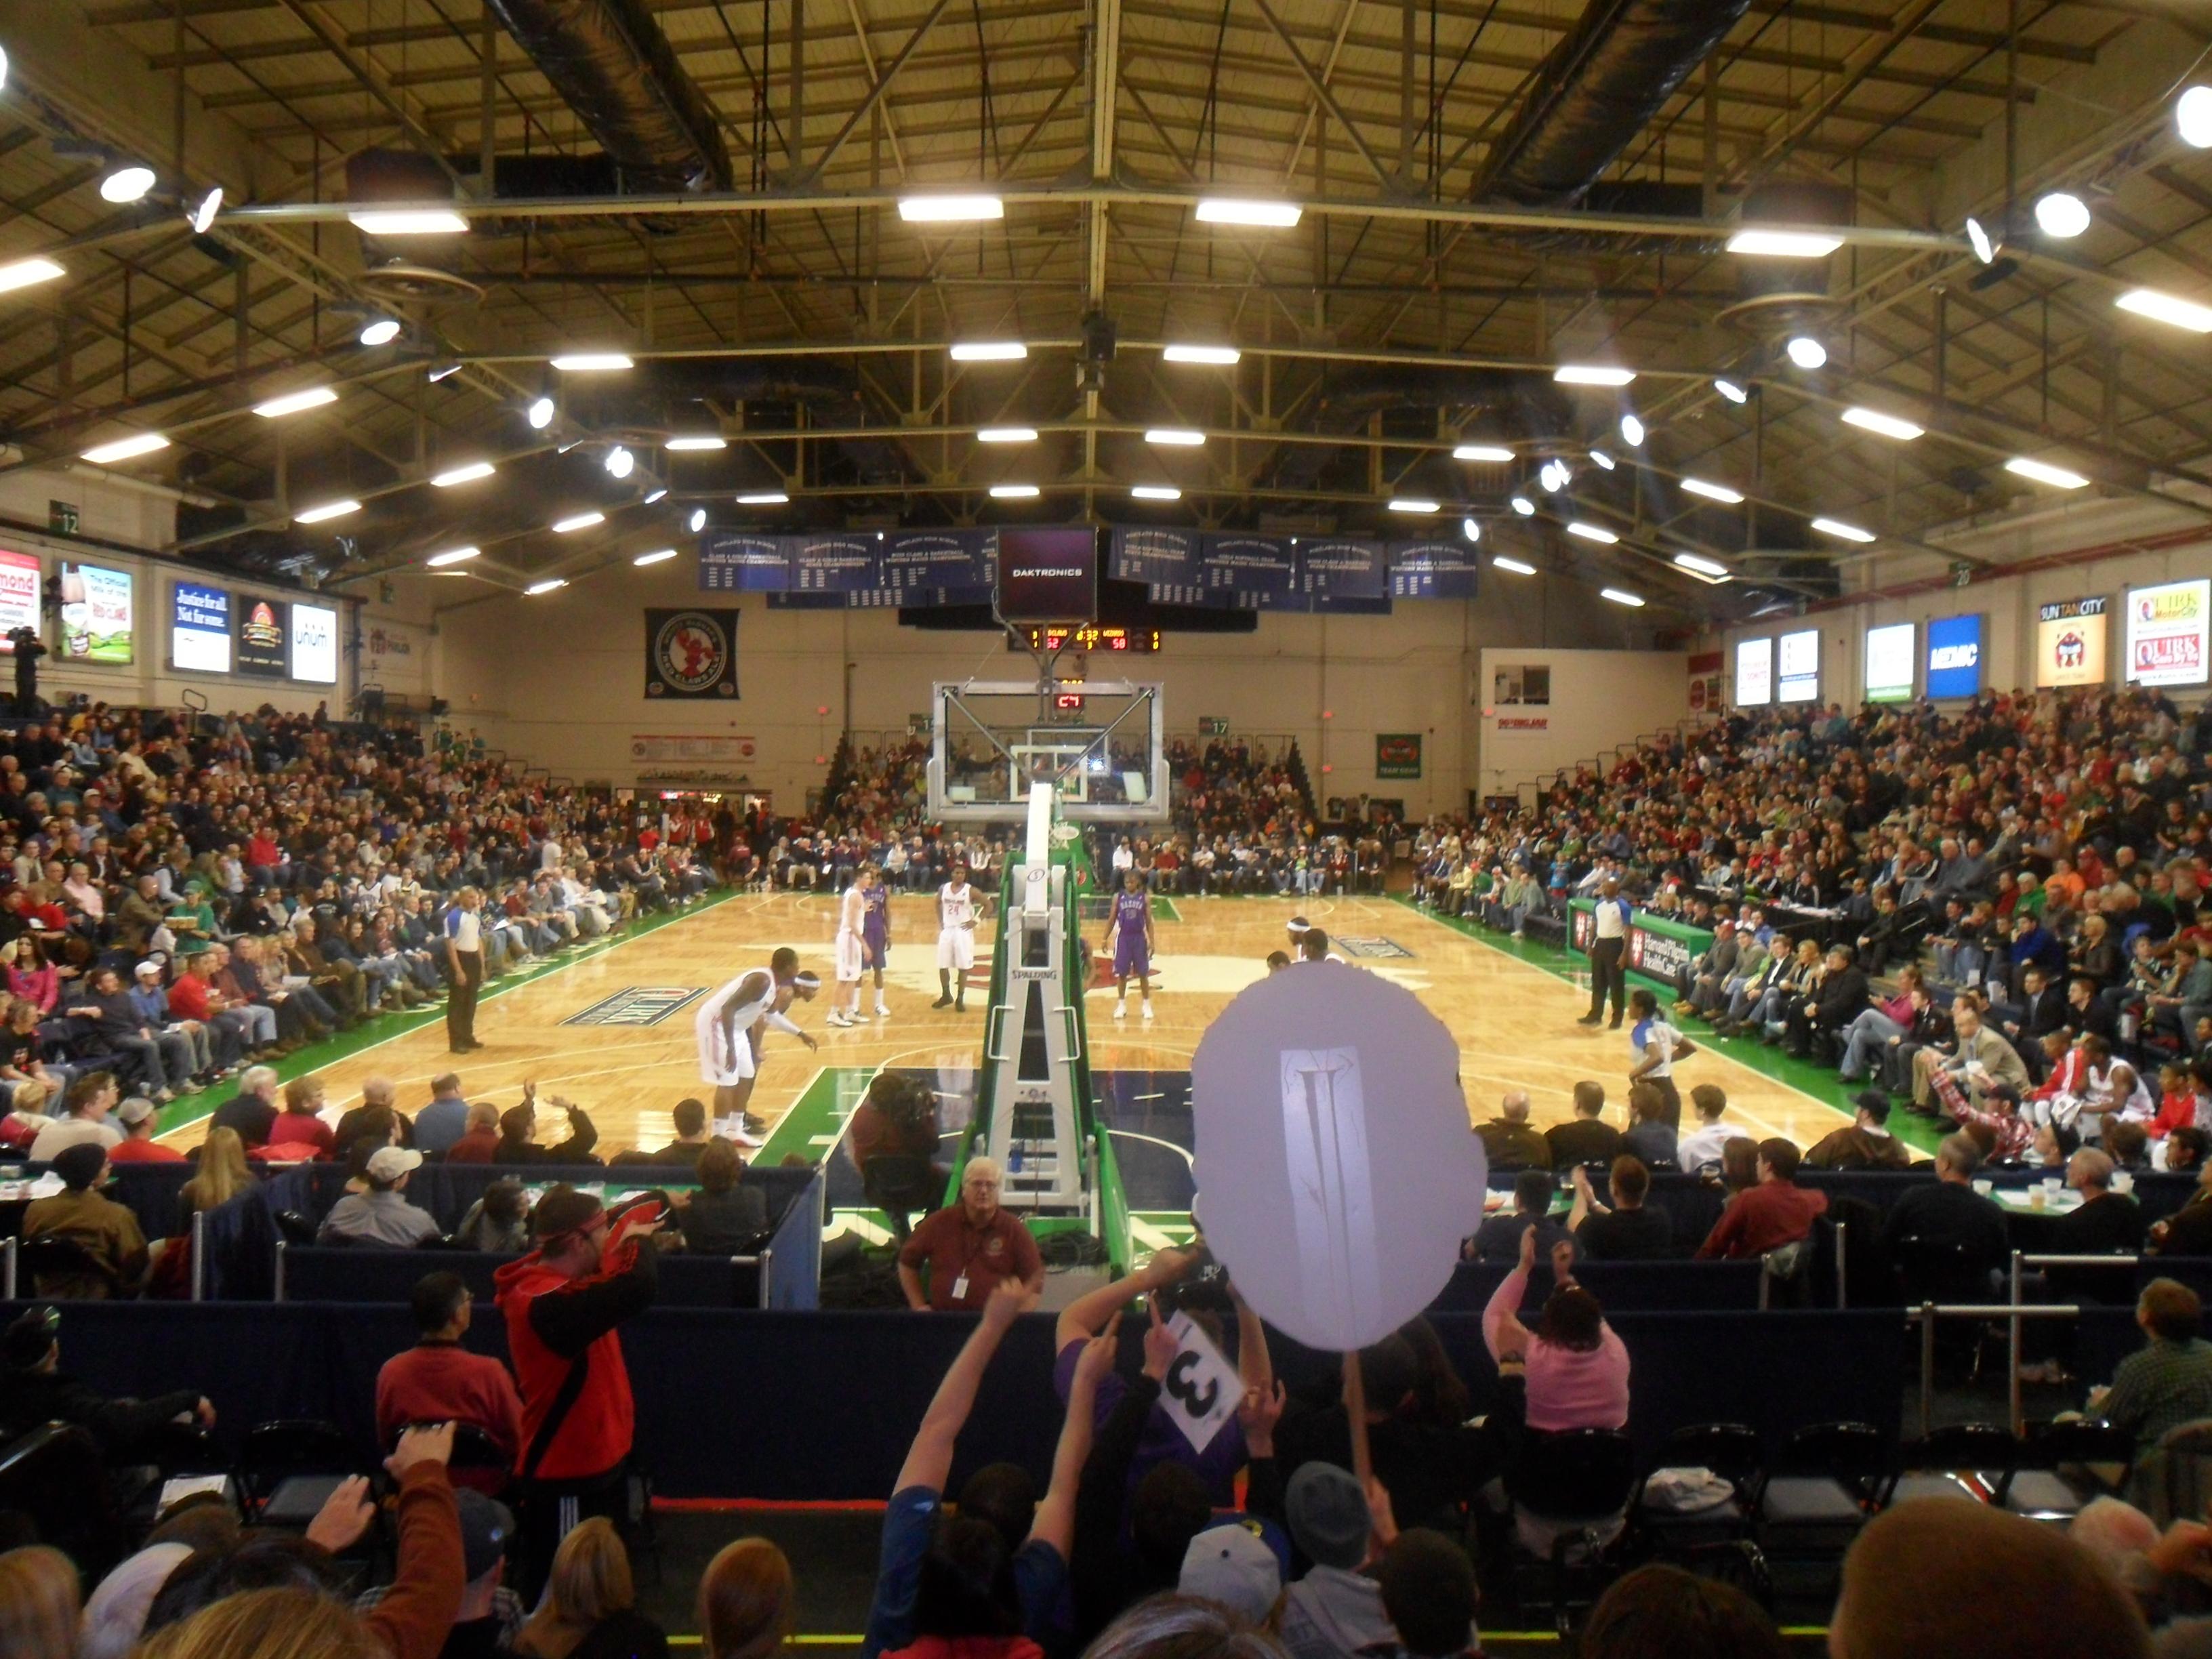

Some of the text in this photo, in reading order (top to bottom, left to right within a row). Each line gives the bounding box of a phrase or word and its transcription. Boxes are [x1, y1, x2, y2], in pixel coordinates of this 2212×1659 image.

[63, 514, 78, 533] 12
[1012, 569, 1083, 577] DAKTRONICS
[177, 589, 205, 607] Justice
[205, 594, 216, 609] for
[177, 606, 192, 621] Not
[194, 609, 204, 624] for
[2041, 597, 2106, 620] SUN TAN CITY
[295, 630, 327, 647] unum
[1213, 722, 1227, 733] 17
[1012, 970, 1057, 980] SPALDING
